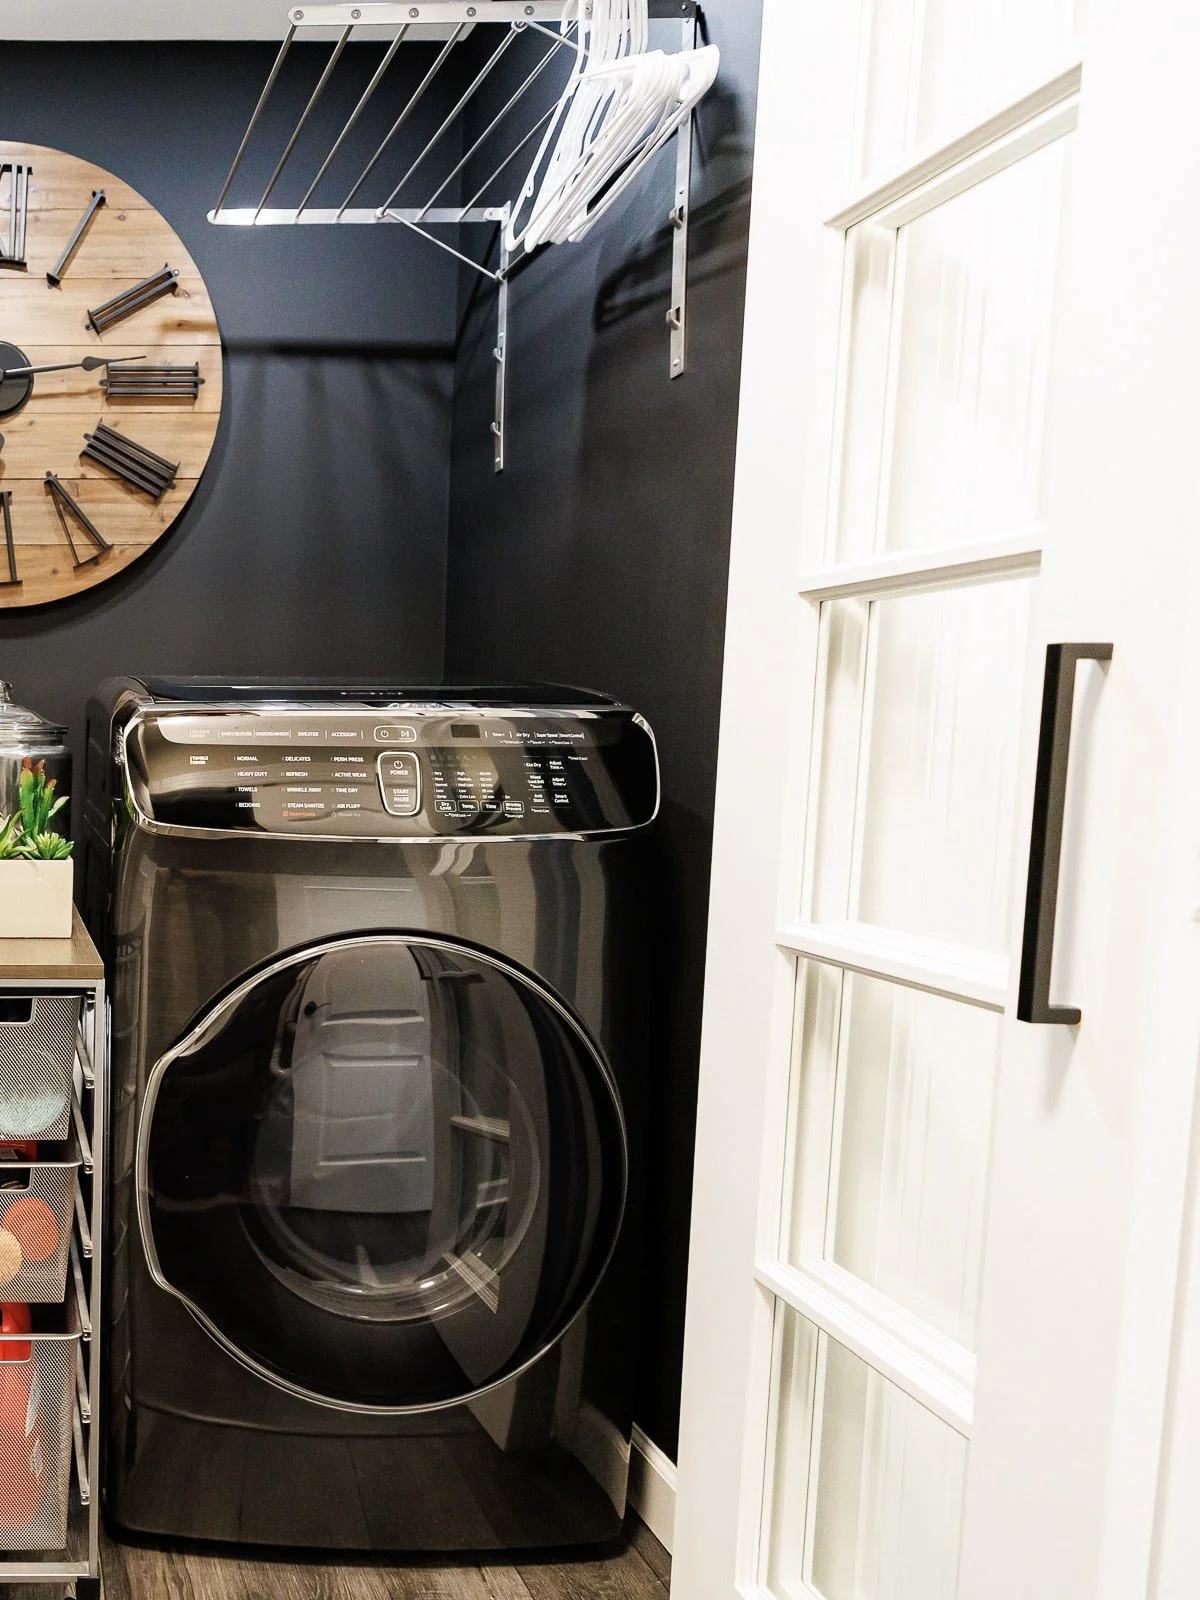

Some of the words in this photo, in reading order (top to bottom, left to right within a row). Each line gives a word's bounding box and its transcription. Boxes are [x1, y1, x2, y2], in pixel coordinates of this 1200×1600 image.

[86, 263, 179, 334] II
[105, 362, 199, 399] III
[45, 472, 113, 569] V
